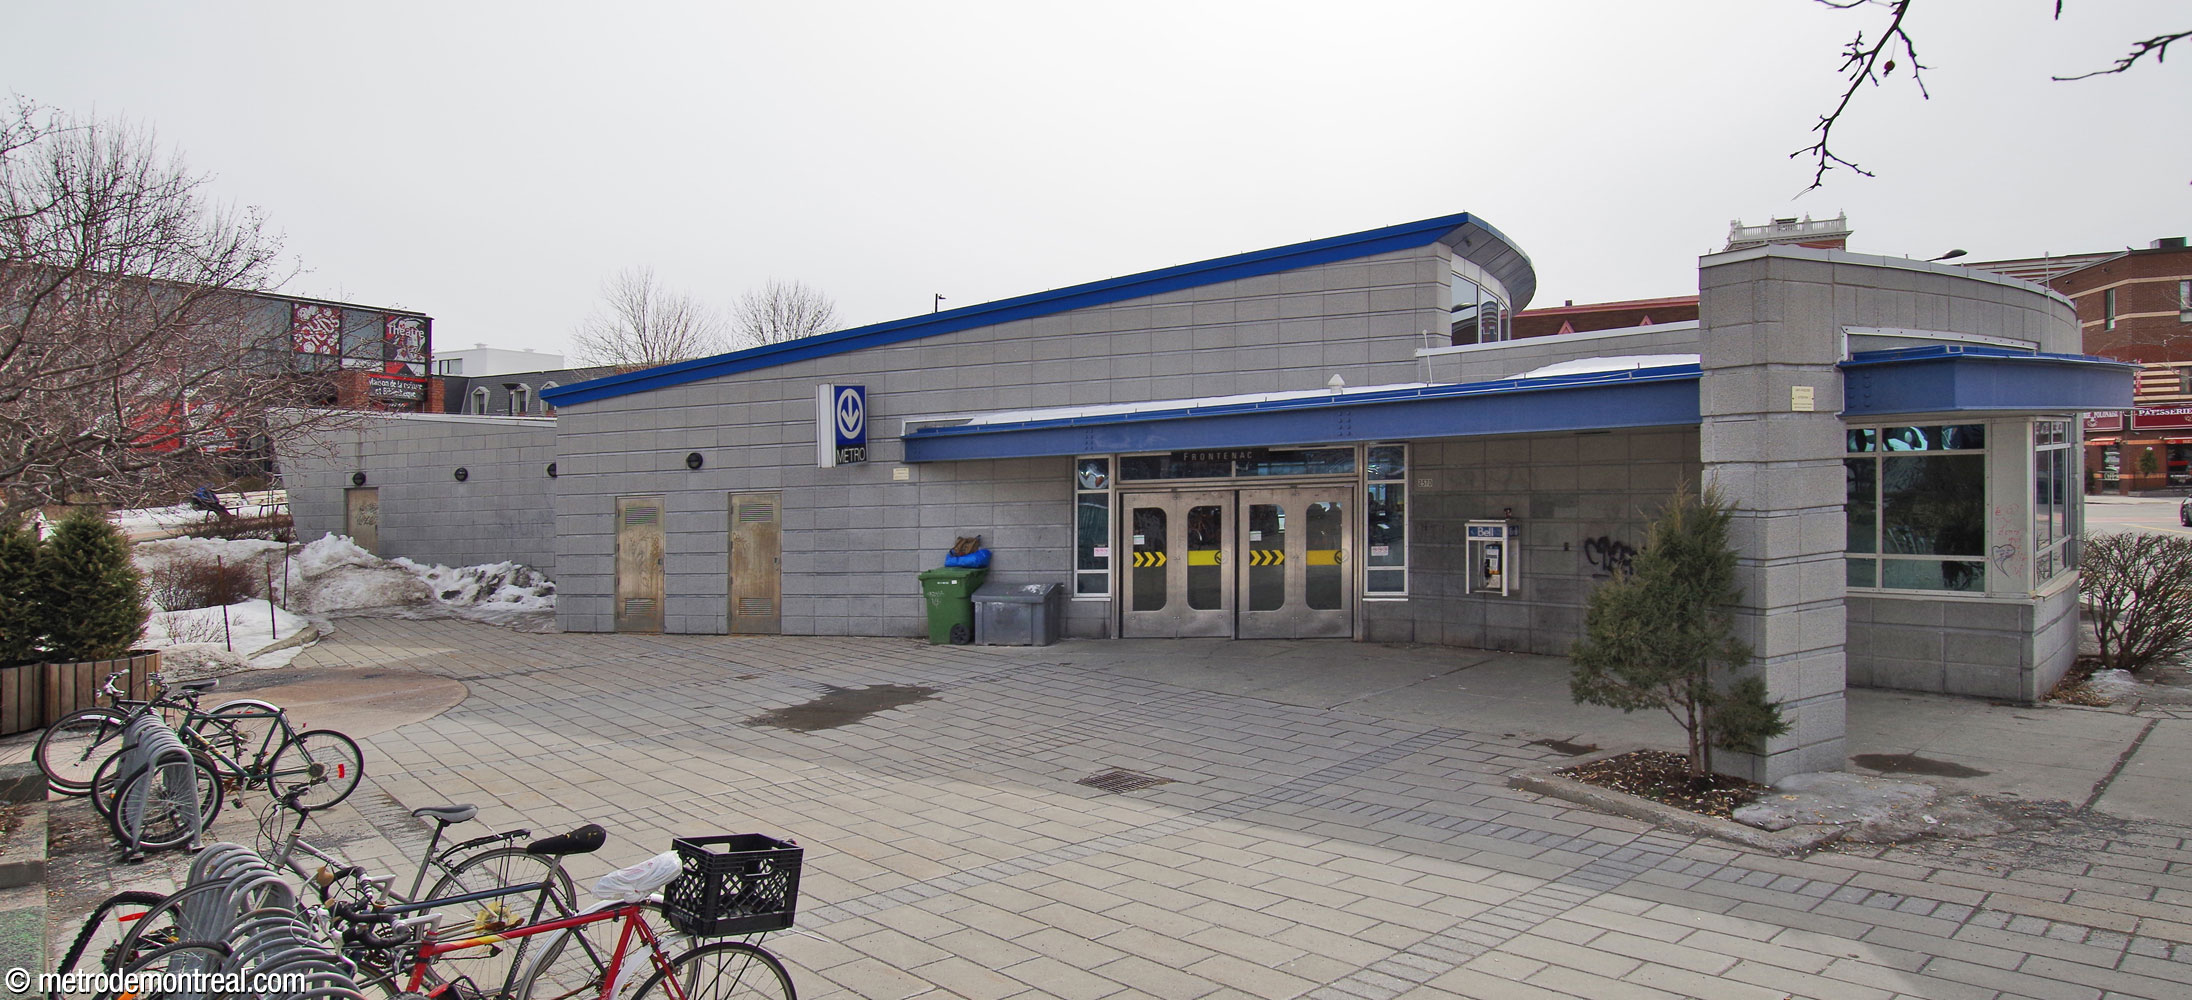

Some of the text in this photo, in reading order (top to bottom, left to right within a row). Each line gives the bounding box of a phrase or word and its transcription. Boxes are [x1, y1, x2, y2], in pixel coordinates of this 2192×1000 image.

[390, 379, 397, 388] de
[1183, 451, 1253, 461] FRONTENAC
[1477, 526, 1494, 537] Bell
